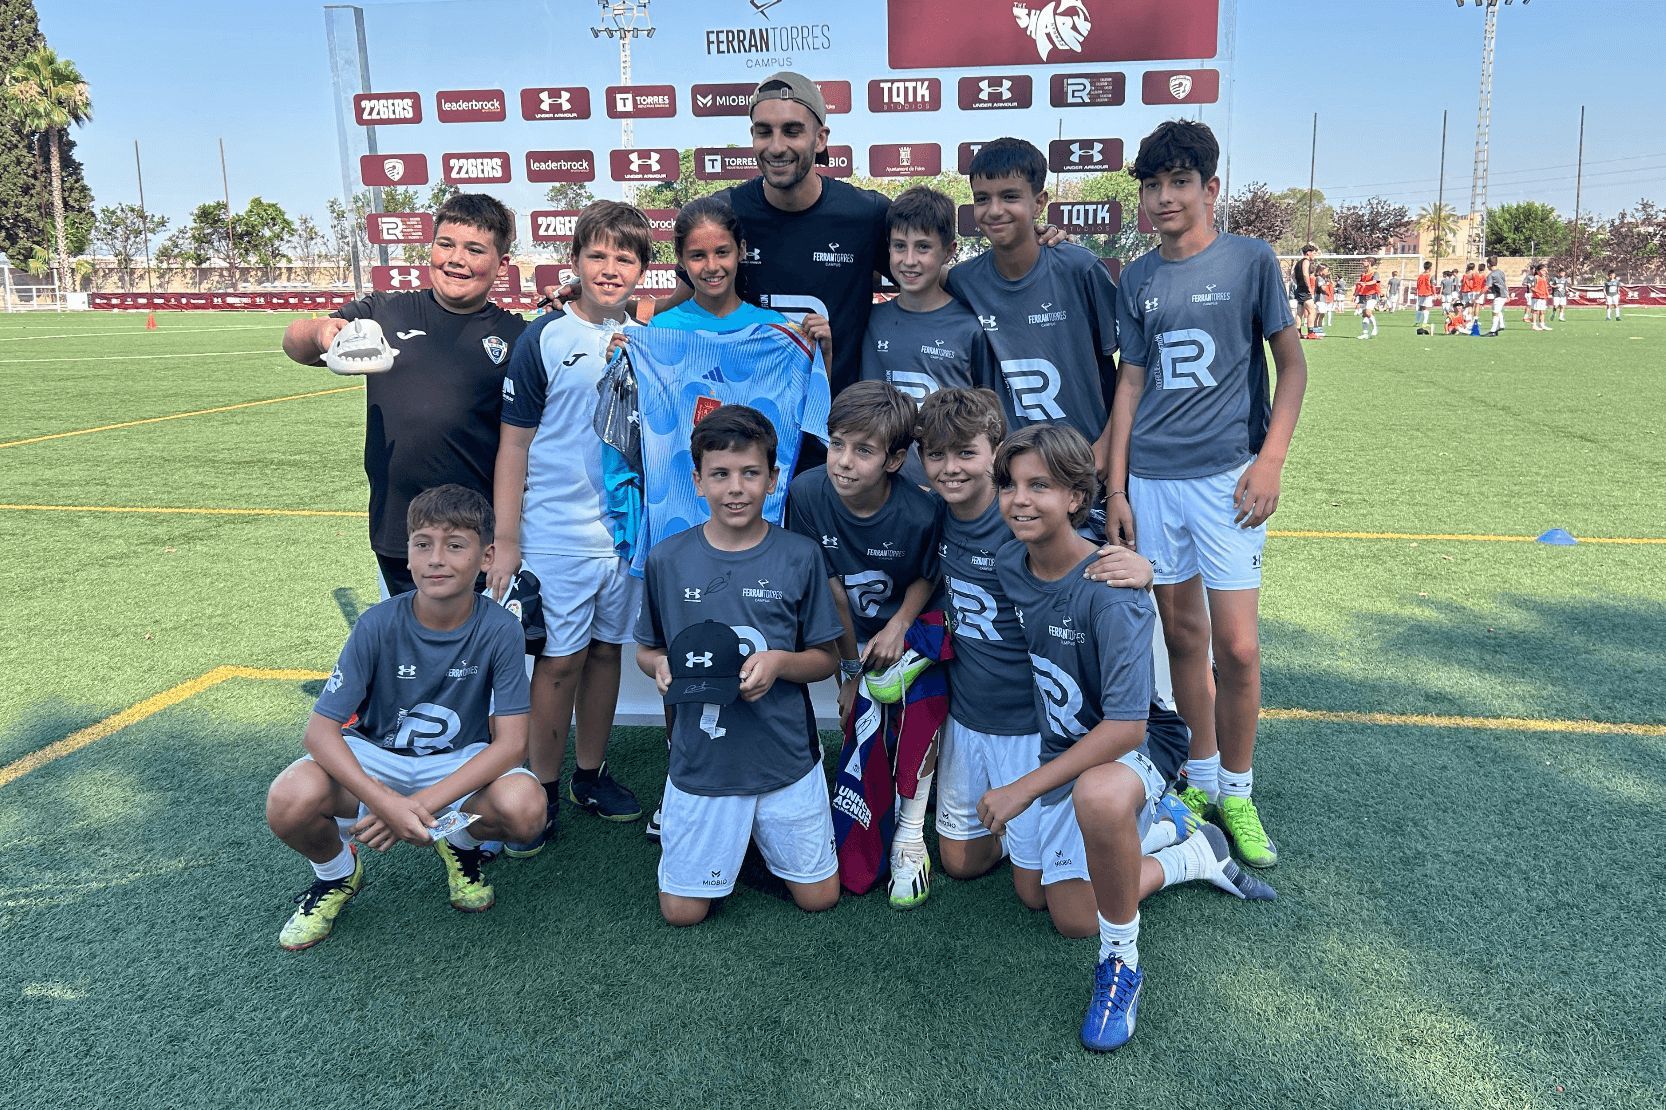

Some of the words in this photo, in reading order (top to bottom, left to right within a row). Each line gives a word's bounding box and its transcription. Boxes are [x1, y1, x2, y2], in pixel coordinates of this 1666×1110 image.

[745, 57, 793, 69] CAMPUS
[441, 98, 501, 111] leaderbrock
[635, 95, 669, 105] TORRES
[361, 98, 414, 120] 226ERS
[530, 158, 589, 170] leaderbrock
[724, 156, 758, 166] TORRES
[449, 157, 504, 179] 226ERS
[832, 795, 871, 828] ACNUR
[702, 878, 728, 886] MIOBIO
